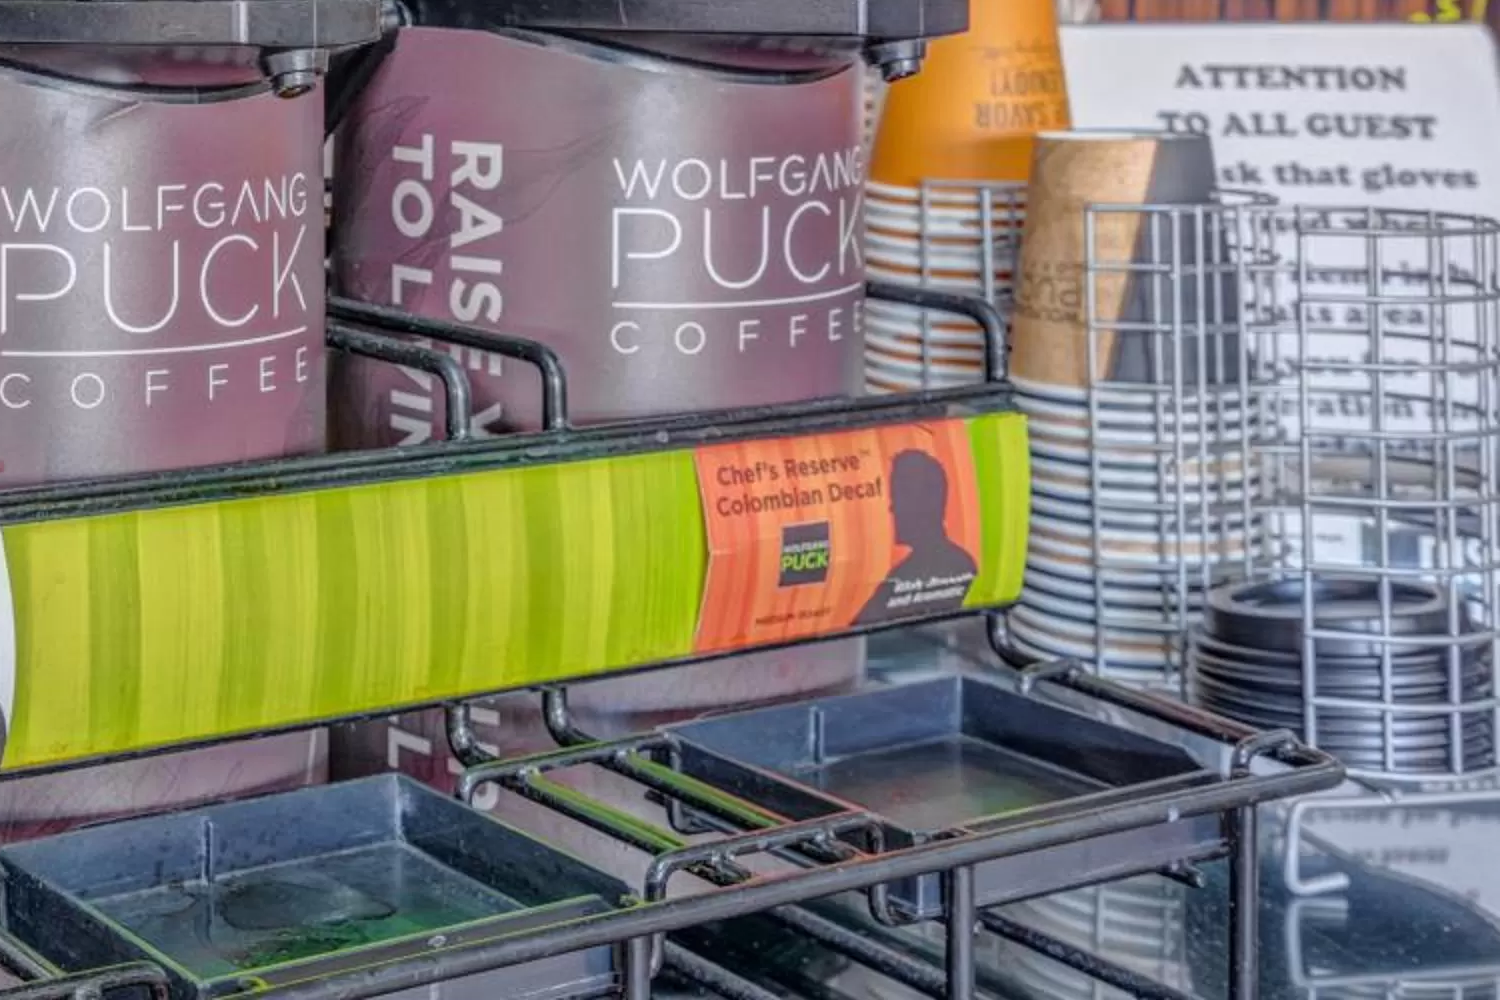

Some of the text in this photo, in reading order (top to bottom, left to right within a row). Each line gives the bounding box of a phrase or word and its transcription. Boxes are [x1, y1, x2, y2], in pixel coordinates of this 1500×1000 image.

[1174, 62, 1408, 92] ATTENTION
[1156, 110, 1438, 140] TO ALL GUEST
[391, 133, 435, 239] TO
[613, 144, 863, 199] WOLFGANG
[1273, 160, 1353, 187] that
[1361, 162, 1481, 194] gloves
[0, 172, 307, 233] WOLFGANG
[611, 192, 863, 289] PUCK
[0, 224, 307, 334] PUCK
[0, 346, 308, 409] COFFEE
[716, 461, 779, 488] Chef's
[716, 476, 883, 518] Colombian Decaf
[781, 551, 829, 573] PUCK
